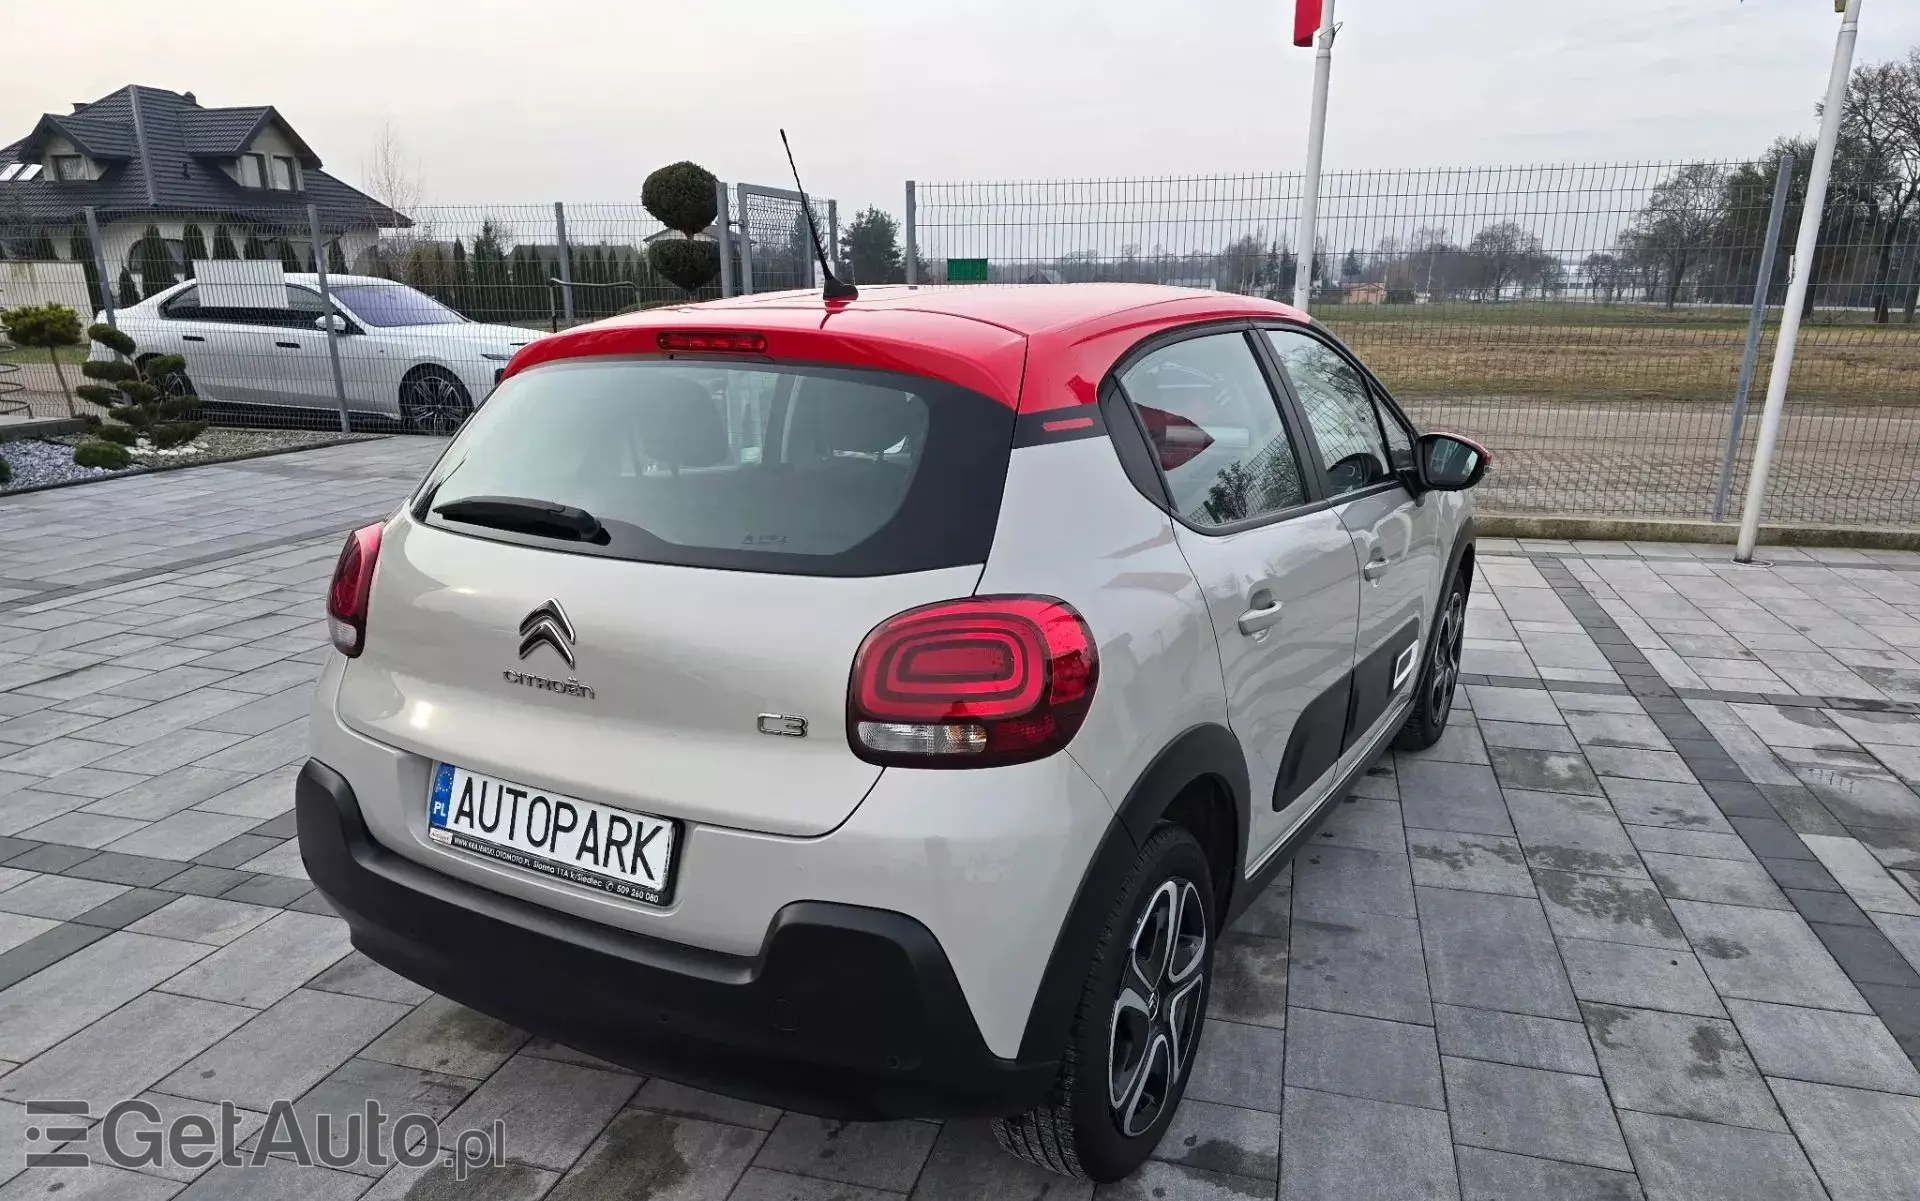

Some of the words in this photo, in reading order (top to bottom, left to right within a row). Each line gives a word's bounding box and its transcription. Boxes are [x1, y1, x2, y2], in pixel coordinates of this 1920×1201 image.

[757, 713, 808, 738] C3
[433, 800, 446, 817] PL
[453, 776, 664, 881] AUTOPARK
[616, 884, 629, 895] 509
[631, 888, 644, 899] 260
[645, 892, 659, 903] 080
